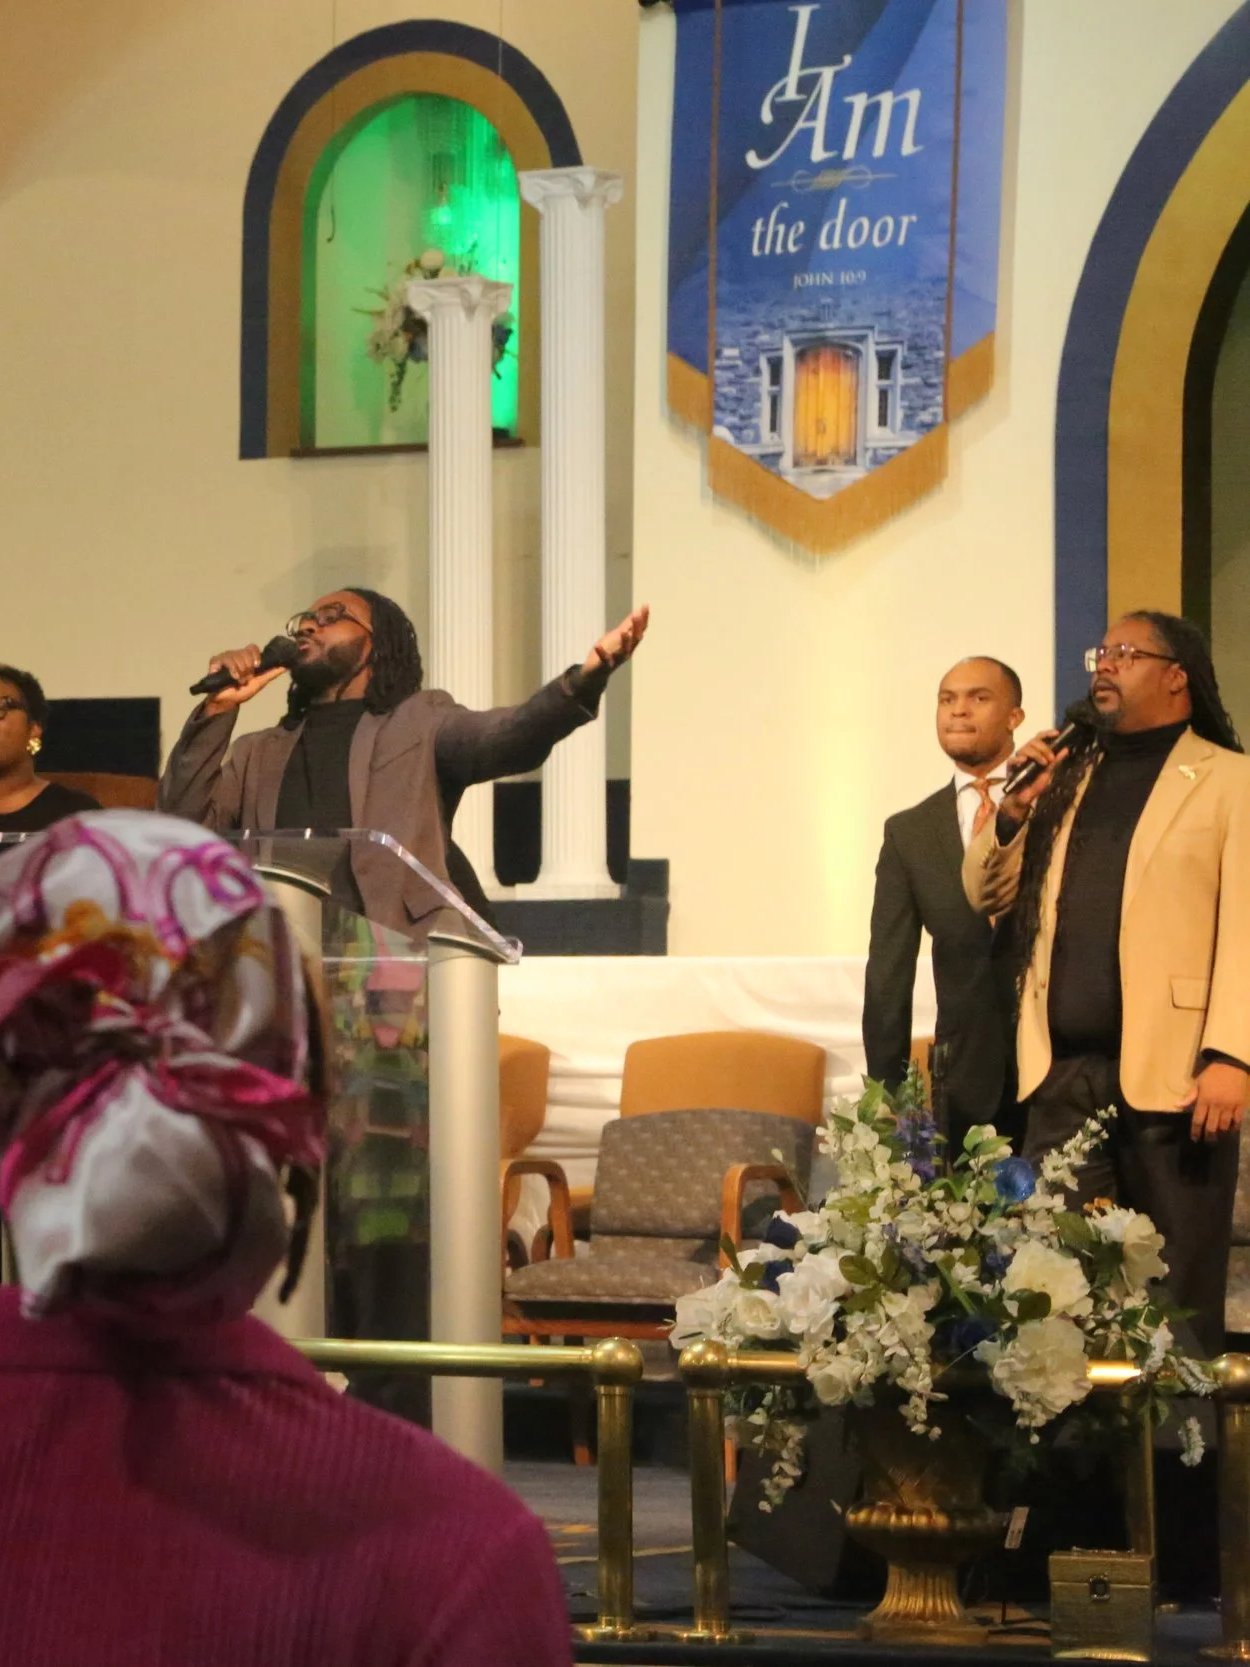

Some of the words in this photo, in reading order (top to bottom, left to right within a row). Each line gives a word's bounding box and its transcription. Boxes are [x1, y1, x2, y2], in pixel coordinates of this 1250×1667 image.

[745, 54, 925, 170] Am
[751, 201, 806, 257] the
[818, 197, 918, 251] door
[793, 271, 835, 290] JOHN
